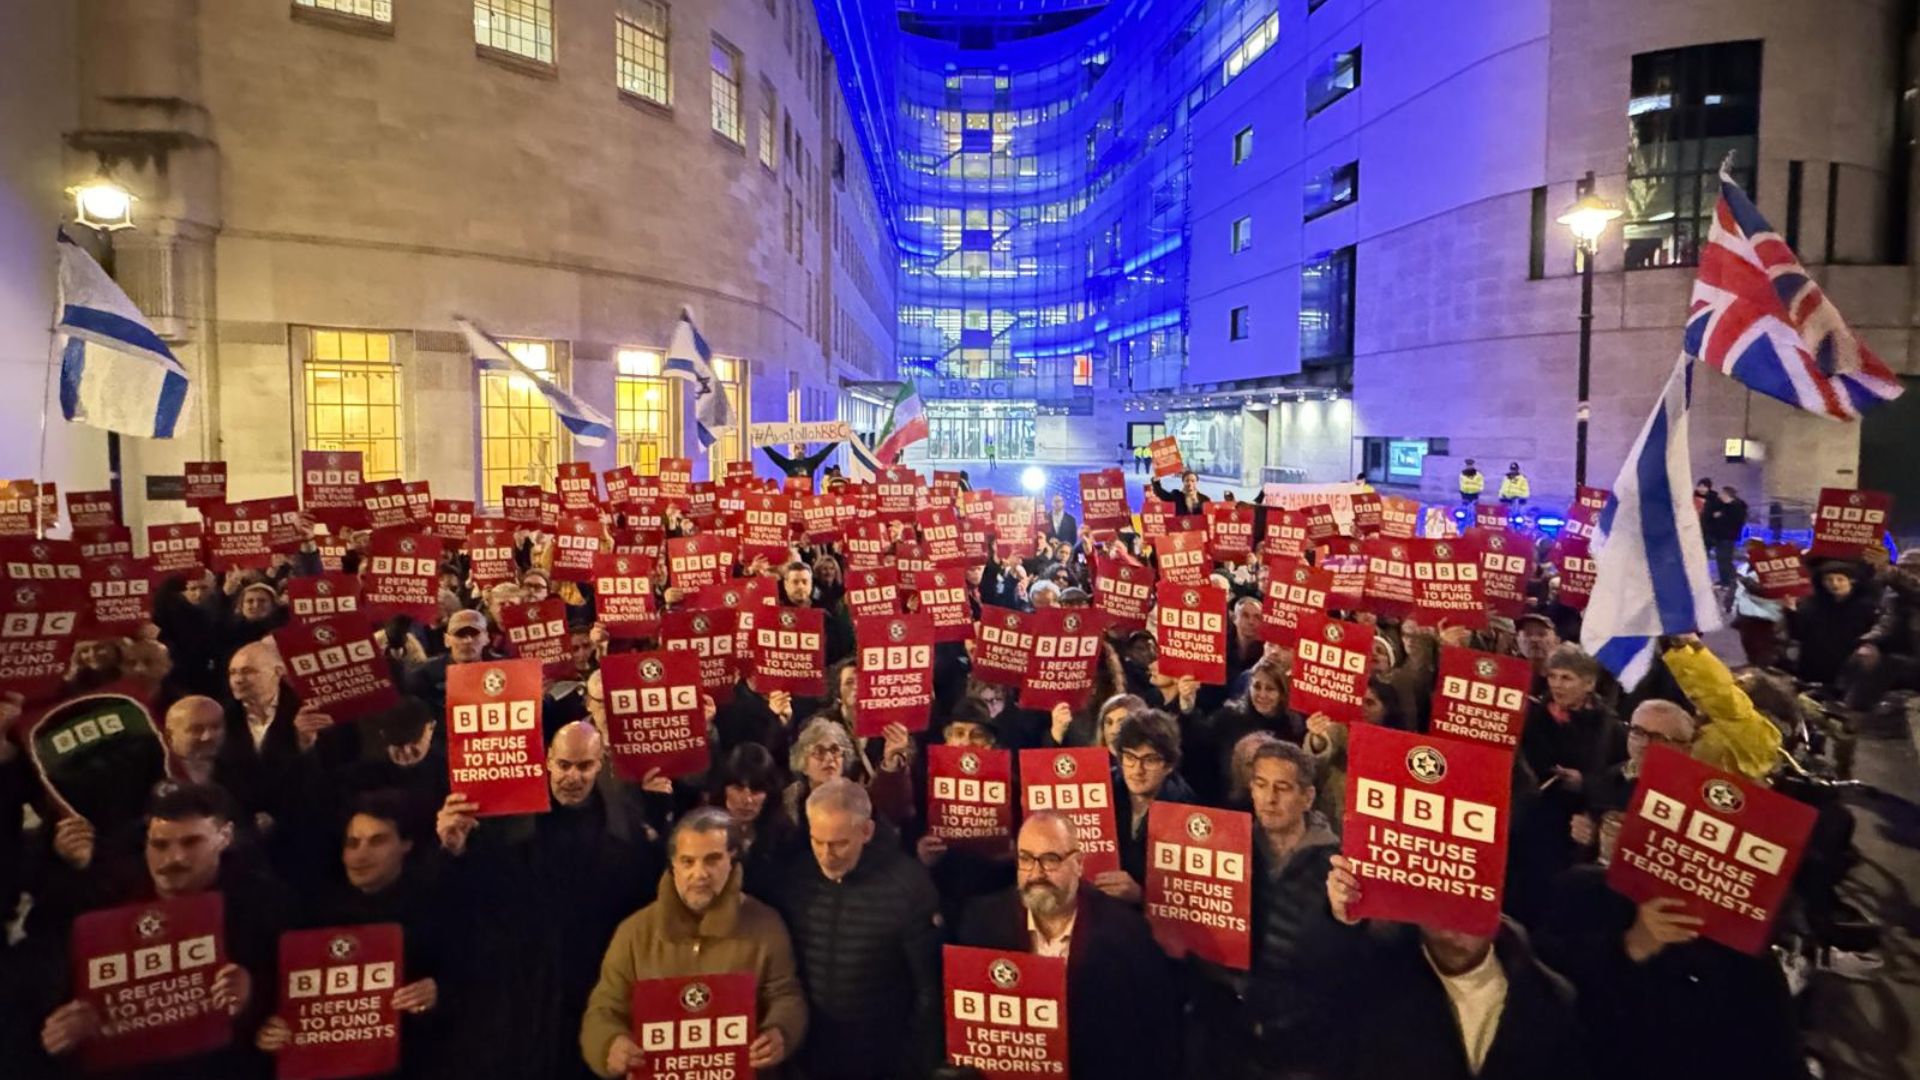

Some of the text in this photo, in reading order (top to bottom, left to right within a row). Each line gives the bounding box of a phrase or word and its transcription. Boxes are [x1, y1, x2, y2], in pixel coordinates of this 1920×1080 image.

[1824, 507, 1882, 522] BBC
[474, 548, 511, 560] BBC
[674, 556, 715, 570] BBC
[1486, 555, 1523, 572] BC
[374, 559, 433, 574] BBC
[1418, 565, 1475, 578] BBC
[378, 578, 428, 587] I REFUSE
[396, 586, 428, 595] FUND
[599, 579, 647, 592] BBC
[1101, 579, 1147, 598] BBC
[1430, 583, 1472, 592] REFUSE
[367, 593, 436, 604] TERRORISTS
[610, 597, 645, 606] REFUSE
[922, 590, 964, 603] BBC
[1272, 583, 1323, 606] BBC
[1424, 591, 1472, 601] TO FUND
[296, 600, 355, 613] BBC
[605, 605, 646, 613] TO FUND
[1416, 599, 1484, 610] TERRORISTS
[5, 614, 73, 635] BC
[598, 613, 656, 622] TERRORISTS
[1164, 610, 1219, 630] BBC
[511, 622, 563, 641] BBC
[760, 631, 817, 648] BBC
[984, 628, 1031, 646] BBC
[1174, 631, 1214, 644] REFUSE
[992, 646, 1028, 659] REFUSE
[1039, 639, 1095, 655] BBC
[1160, 645, 1224, 664] TERRORISTS
[1168, 639, 1214, 653] TO FUND
[294, 642, 371, 673] BBC
[765, 651, 813, 662] I REFUSE
[766, 659, 814, 670] TO FUND
[866, 648, 927, 668] BBC
[977, 657, 1028, 673] TERRORIST
[986, 652, 1028, 666] TO FUND
[1041, 661, 1087, 670] I REFUSE
[1302, 642, 1361, 670] BBC
[309, 664, 373, 686] I REFUSE
[757, 667, 823, 679] TERRORISTS
[871, 673, 923, 685] I REFUSE
[1040, 671, 1087, 680] TO FUND
[1303, 663, 1355, 685] I REFUSE
[311, 674, 375, 695] TO FUND
[870, 685, 923, 697] TO FUND
[1027, 679, 1092, 691] TERRORISTS
[1303, 672, 1354, 694] TO FUND
[614, 688, 693, 712] BBC
[860, 695, 930, 709] TERRORISTS
[1293, 680, 1363, 706] TERRORISTS
[1447, 680, 1519, 707] BBC
[457, 704, 531, 730] BBC
[1448, 702, 1509, 723] I REFUSE
[624, 716, 690, 730] I REFUSE
[1447, 712, 1508, 733] TO FUND
[58, 716, 120, 749] BBC
[625, 727, 691, 742] TO FUND
[1434, 721, 1517, 745] TERRORISTS
[464, 736, 527, 751] I REFUSE
[613, 737, 706, 756] TERRORISTS
[463, 751, 528, 766] TO FUND
[452, 765, 543, 782] TERRORISTS
[937, 780, 1002, 801] BBC
[1031, 785, 1104, 807] BBC
[942, 804, 997, 817] I REFUSE
[1073, 813, 1100, 825] USE
[1361, 781, 1491, 838] BBC
[942, 815, 998, 828] TO FUND
[931, 825, 1008, 838] TERRORISTS
[1645, 794, 1781, 871] BBC
[1369, 825, 1477, 862] I REFUSE
[1159, 845, 1240, 878] BBC
[1368, 845, 1476, 880] TO FUND
[1648, 830, 1756, 887] I REFUSE
[1349, 858, 1496, 901] TERRORISTS
[1644, 841, 1751, 899] TO FUND
[1164, 877, 1233, 899] I REFUSE
[1621, 848, 1766, 920] TERRORISTS
[1162, 891, 1233, 913] TO FUND
[1149, 902, 1247, 931] TERRORISTS
[94, 939, 211, 985] BBC
[105, 972, 204, 1005] I REFUSE
[293, 965, 390, 995] BBC
[109, 987, 205, 1018] TO FUND
[300, 996, 381, 1016] I REFUSE
[958, 993, 1053, 1025] BBC
[300, 1012, 381, 1031] TO FUND
[295, 1024, 396, 1045] ERRORISTS
[646, 1020, 743, 1048] BBC
[967, 1026, 1047, 1046] I REFUSE
[966, 1041, 1047, 1060] TO FUND
[654, 1052, 736, 1071] I REFUSE
[952, 1054, 1064, 1074] TERRORISTS
[685, 1068, 736, 1080] FUND
